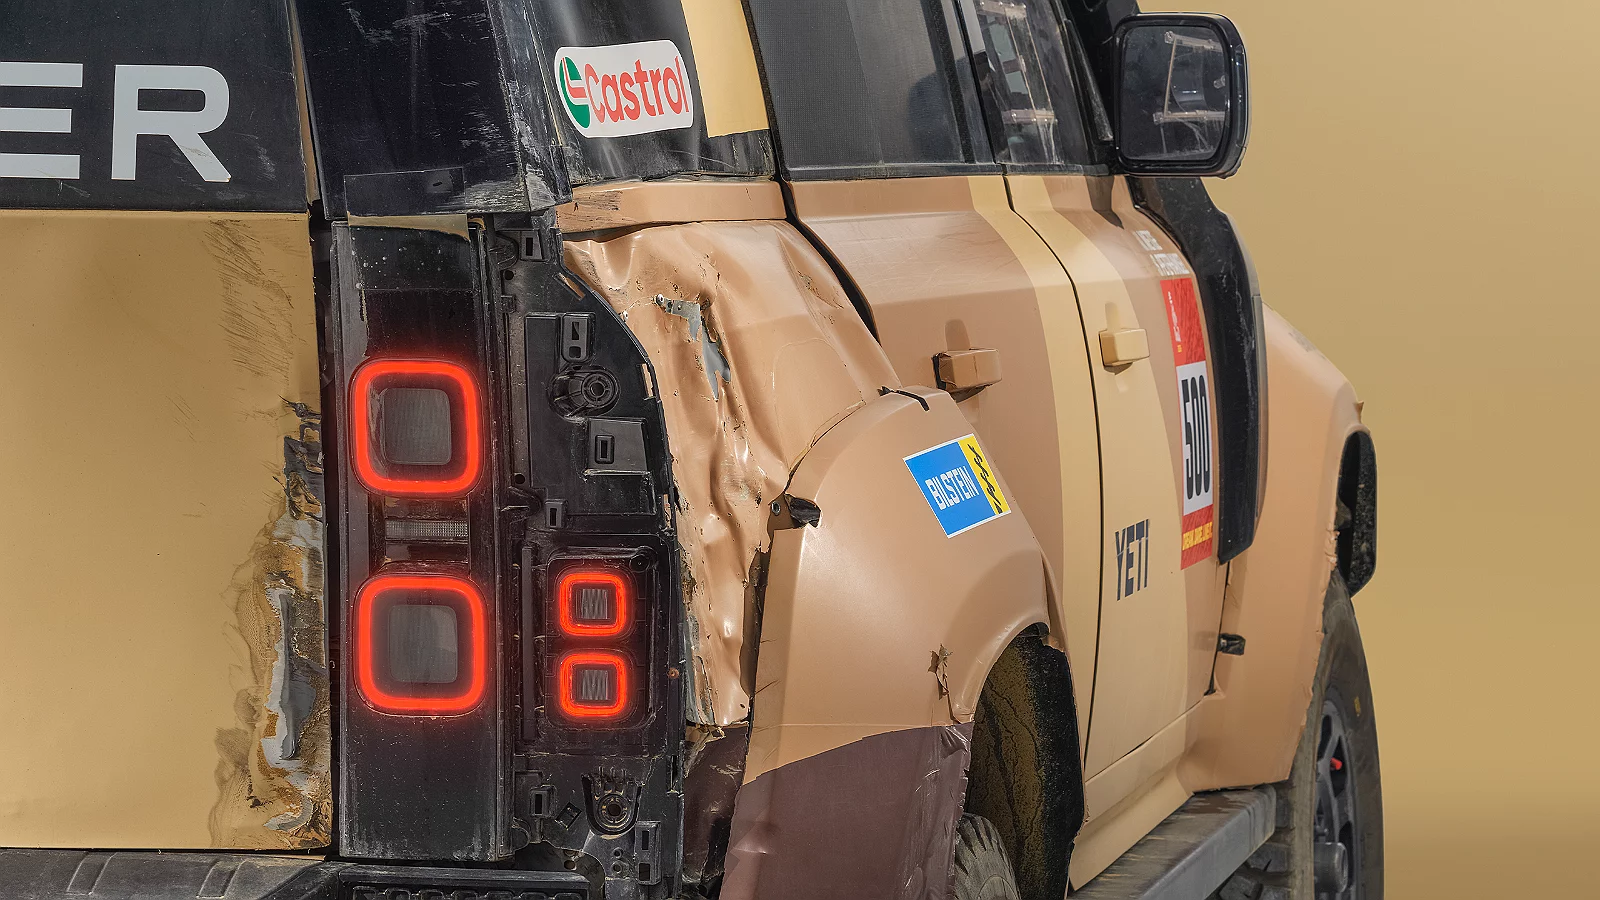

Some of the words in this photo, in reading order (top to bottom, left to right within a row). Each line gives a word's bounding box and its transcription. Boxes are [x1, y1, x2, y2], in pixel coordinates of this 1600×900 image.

[0, 62, 232, 182] ER
[585, 55, 690, 123] Castrol
[1181, 374, 1211, 500] 500
[925, 465, 980, 511] BILSTEIN
[1115, 518, 1149, 602] YETI
